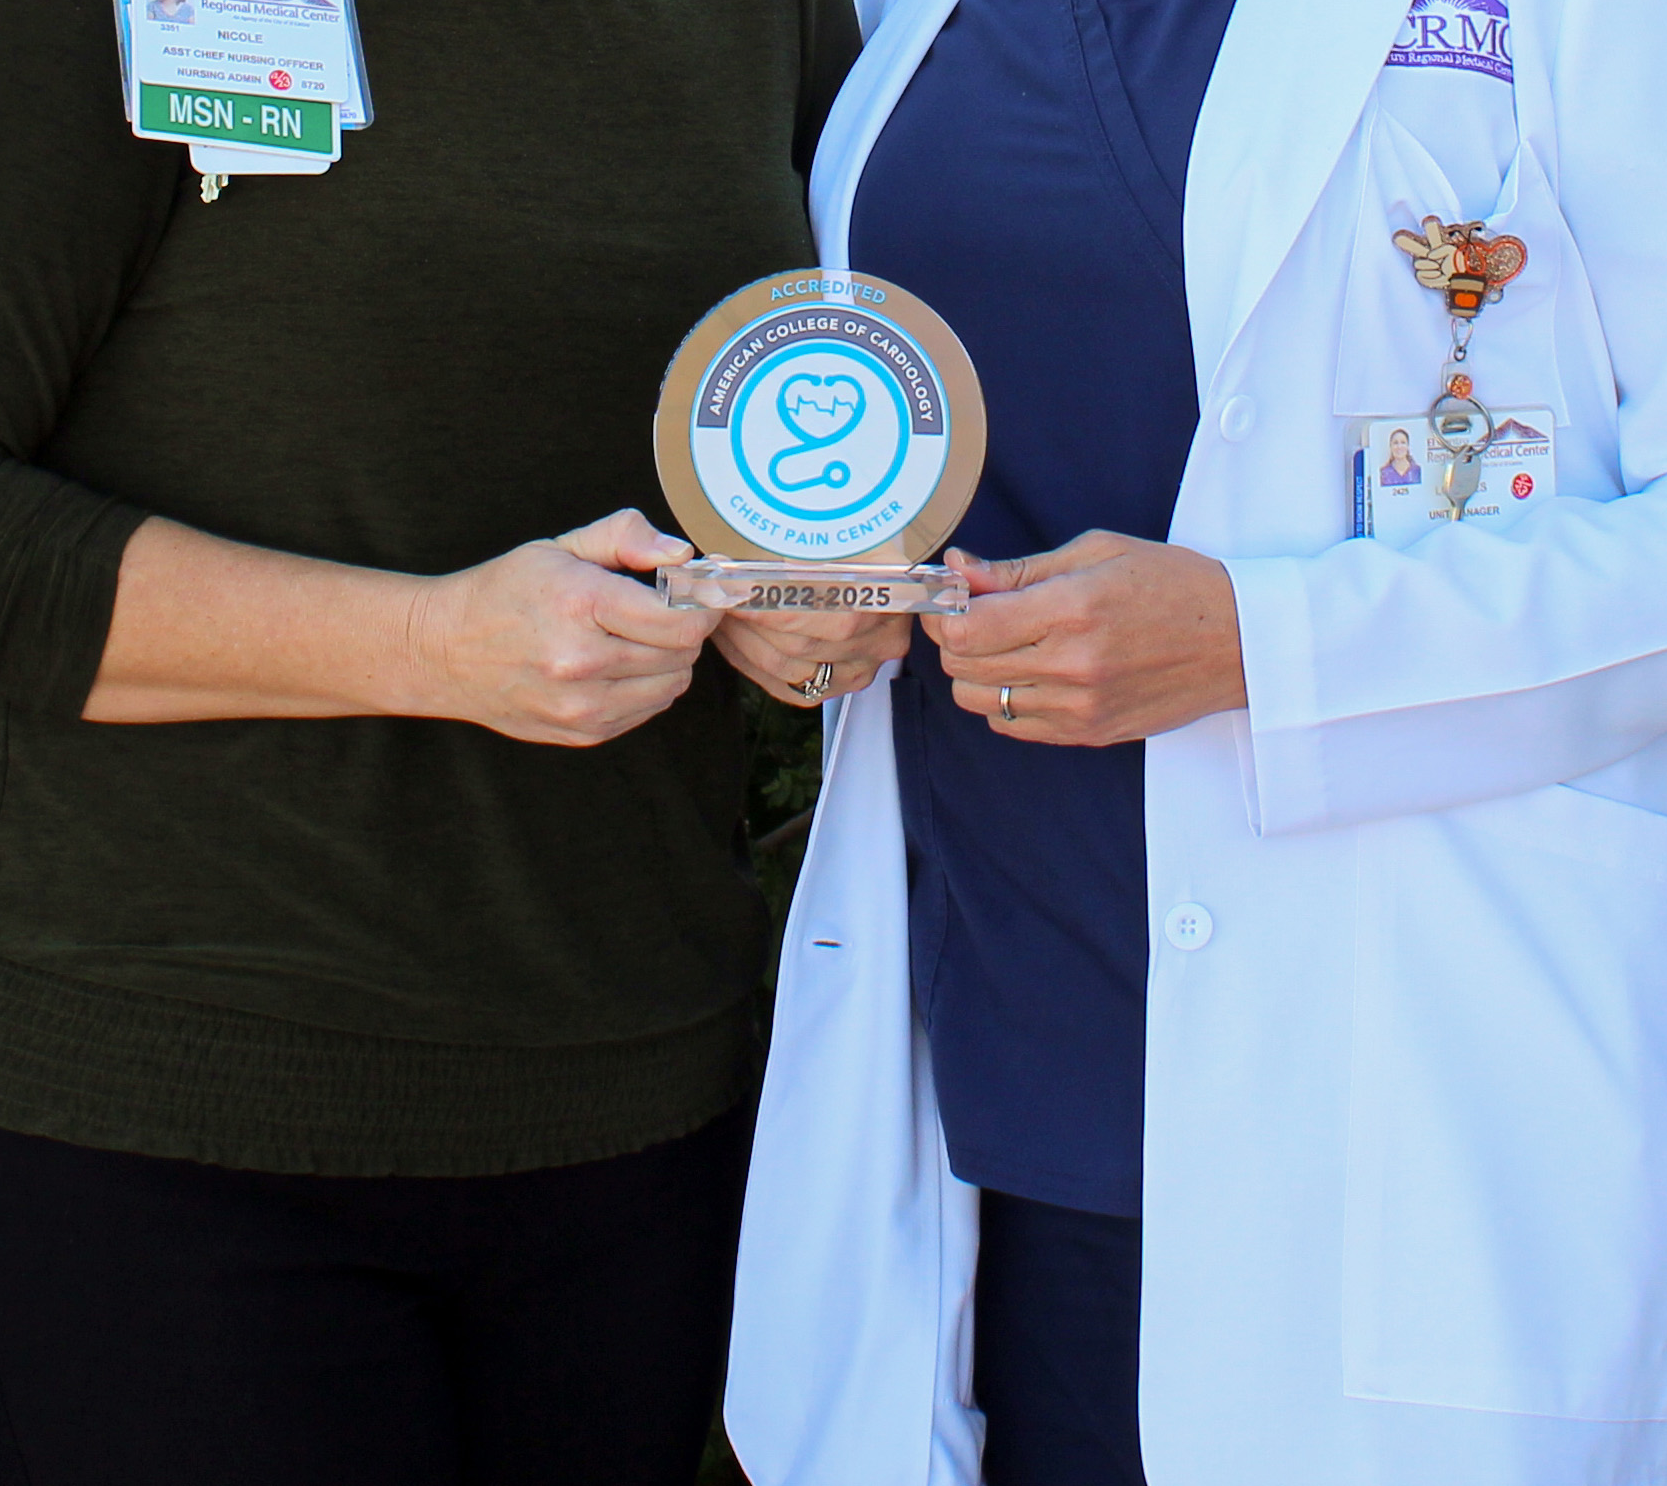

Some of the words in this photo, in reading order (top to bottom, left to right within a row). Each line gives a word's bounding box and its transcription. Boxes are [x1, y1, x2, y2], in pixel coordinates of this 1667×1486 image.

[254, 3, 299, 18] Medical
[301, 9, 341, 23] Center
[218, 30, 263, 44] NICOLE
[163, 46, 191, 56] ASST
[194, 49, 224, 60] CHIEF
[228, 53, 275, 65] NURSING
[278, 58, 324, 71] OFFICER
[177, 67, 225, 80] NURSING
[228, 73, 262, 84] ADMIN
[169, 93, 234, 130] MSN
[260, 104, 302, 139] RN
[771, 279, 886, 304] ACCREDITED
[710, 338, 764, 415] AMERICAN
[765, 317, 839, 344] COLLEGE
[843, 320, 867, 337] OF
[869, 331, 934, 422] CARDIOLOGY
[1483, 445, 1513, 459] edical
[1515, 444, 1549, 457] Center
[729, 494, 780, 537] CHEST
[784, 528, 829, 546] PAIN
[837, 500, 903, 543] CENTER
[1429, 509, 1450, 520] UNIT
[1462, 505, 1500, 517] NAGER
[750, 585, 890, 607] 2022-2025
